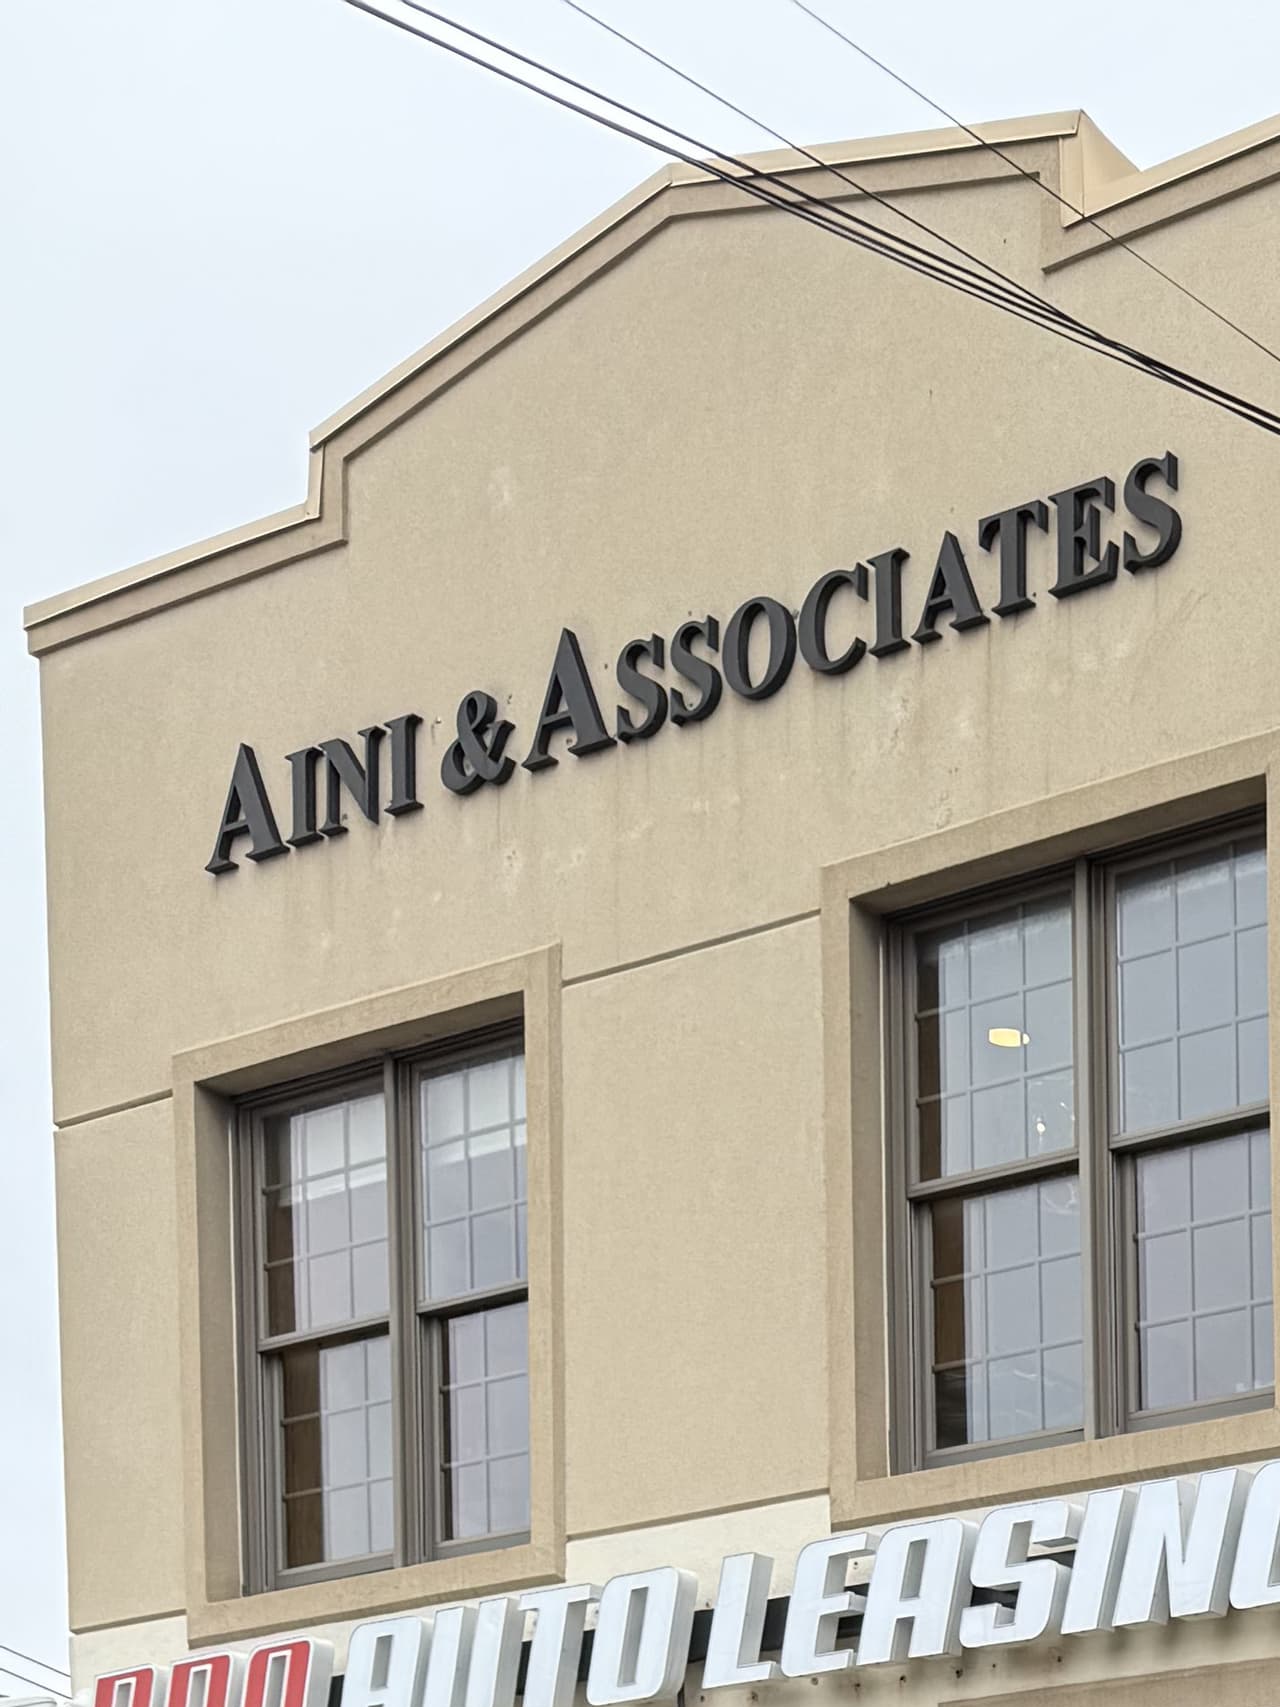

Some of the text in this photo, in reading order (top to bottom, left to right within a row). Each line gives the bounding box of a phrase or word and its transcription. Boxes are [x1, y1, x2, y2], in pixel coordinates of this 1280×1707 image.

[204, 451, 1183, 875] AINI & ASSOCIATES
